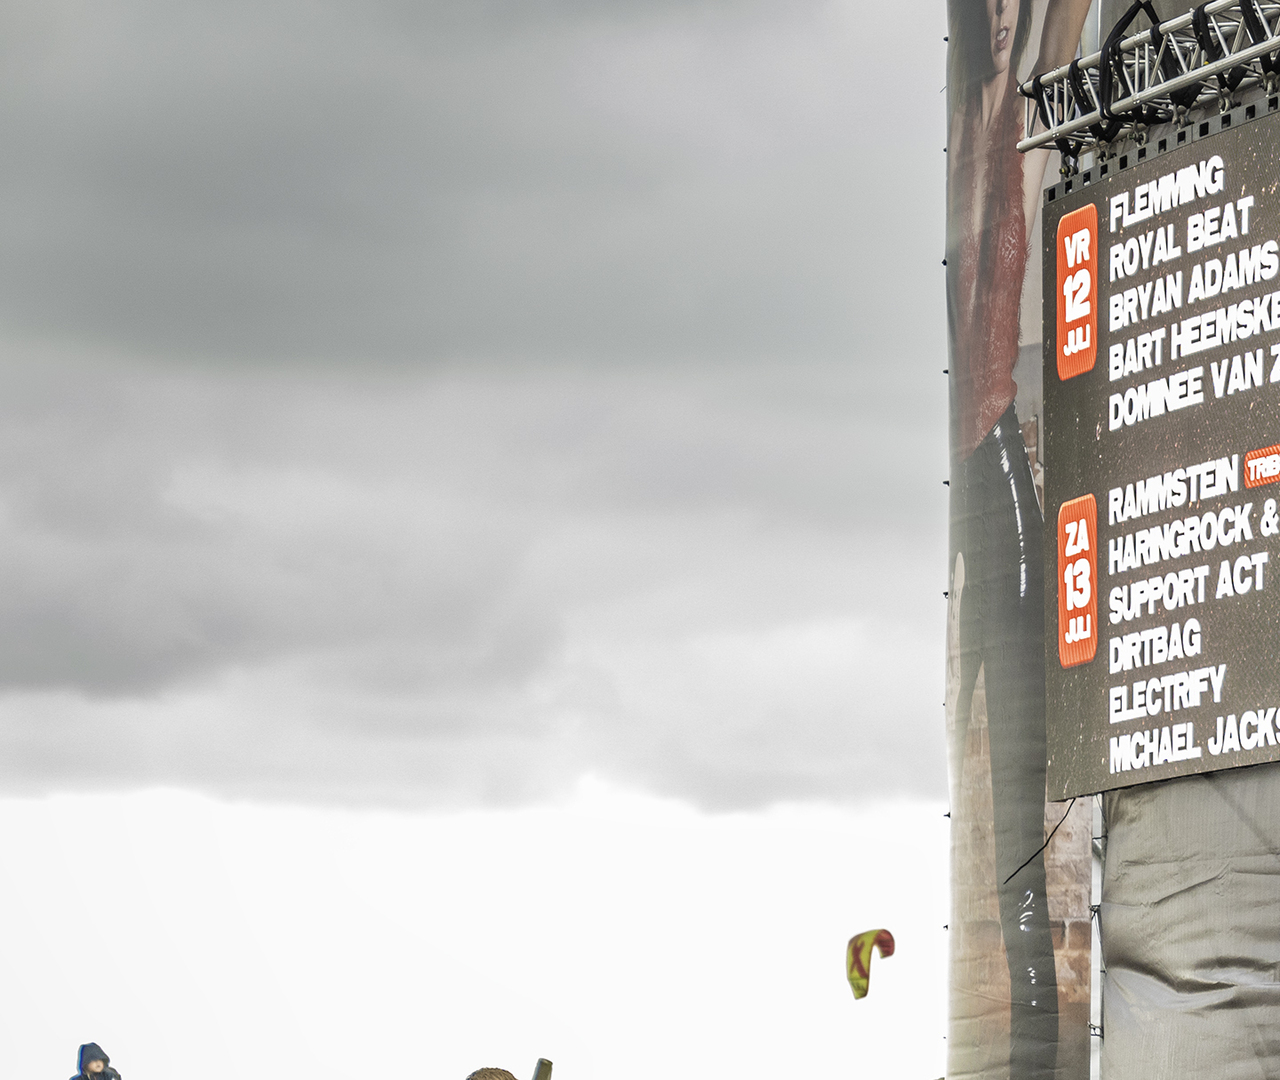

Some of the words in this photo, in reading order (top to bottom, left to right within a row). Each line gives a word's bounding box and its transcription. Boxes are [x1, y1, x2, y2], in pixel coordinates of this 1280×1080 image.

[1110, 156, 1223, 232] FLEMMING
[1065, 229, 1090, 267] VR
[1110, 224, 1181, 282] ROYAL
[1188, 196, 1254, 253] BEAT
[1064, 269, 1090, 322] 12
[1110, 271, 1182, 331] BRYAN
[1188, 240, 1278, 303] ADAMS
[1064, 324, 1090, 356] JULI
[1110, 328, 1165, 381] BART
[1109, 366, 1203, 431] DOMINEE
[1211, 349, 1263, 398] VAN
[1109, 454, 1238, 525] RAMMSTEIN
[1066, 519, 1089, 556] ZA
[1109, 503, 1253, 575] HARINGROCK
[1261, 499, 1279, 536] &
[1065, 559, 1090, 610] 13
[1109, 565, 1209, 624] SUPPORT
[1216, 552, 1268, 599] ACT
[1065, 614, 1090, 643] JULI
[1110, 618, 1201, 674] DIRTBAG
[1110, 664, 1226, 724] ELECTRIFY
[1110, 722, 1201, 774] MICHAEL
